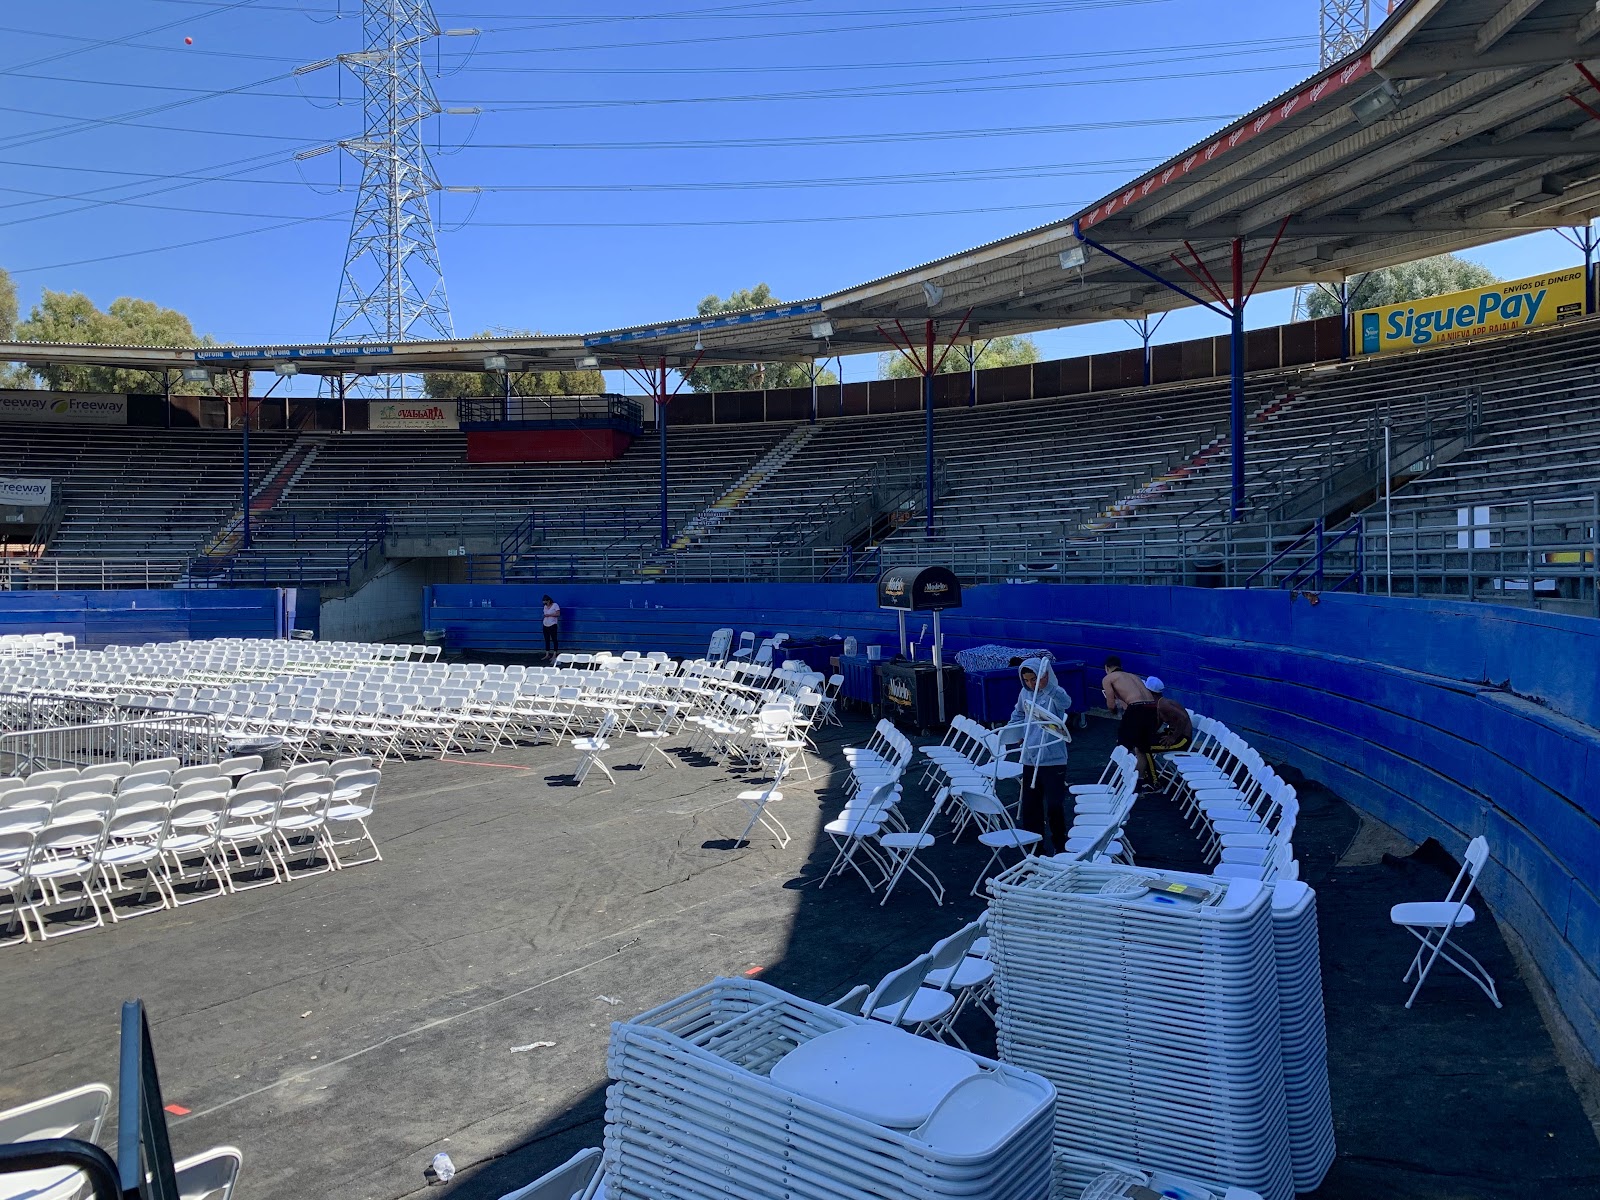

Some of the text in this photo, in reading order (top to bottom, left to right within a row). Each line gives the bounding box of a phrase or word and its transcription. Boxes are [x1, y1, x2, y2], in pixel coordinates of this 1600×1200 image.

[1503, 272, 1582, 294] ENVÍOS DE DINERO
[1386, 290, 1546, 343] SiguePay
[197, 346, 390, 359] Corona Corona Corona Corona Corona Corona
[69, 399, 124, 413] Freeway
[17, 514, 24, 522] 4
[459, 545, 466, 556] 5
[926, 582, 946, 591] Modelo
